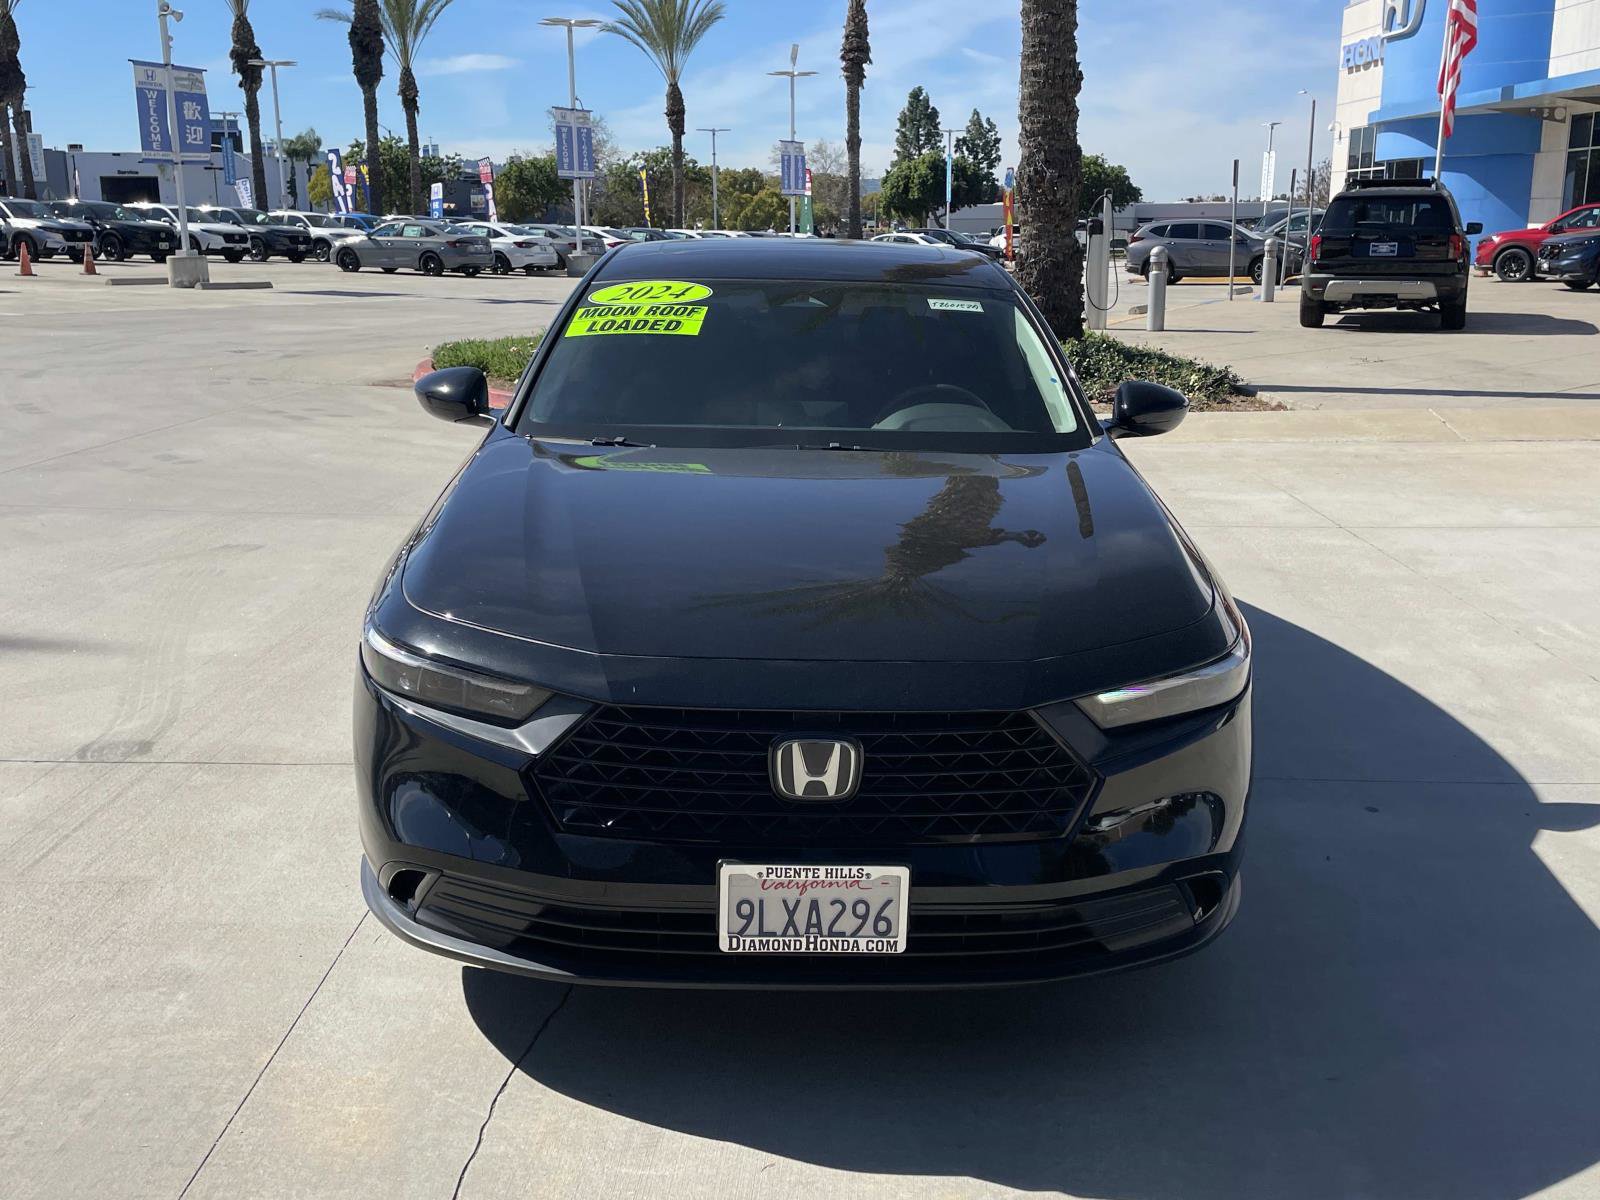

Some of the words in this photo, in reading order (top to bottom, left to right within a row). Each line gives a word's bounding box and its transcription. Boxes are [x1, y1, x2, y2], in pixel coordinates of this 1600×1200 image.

[144, 89, 162, 151] WELCOME
[183, 101, 203, 145] 歡迎
[560, 126, 570, 170] WELCOME
[608, 284, 696, 302] 2024
[579, 305, 642, 319] MOON
[644, 305, 703, 318] ROOF
[586, 318, 684, 333] LOADED
[766, 867, 820, 879] PUENTE
[824, 867, 866, 880] HILLS
[735, 898, 894, 938] 9LXA296
